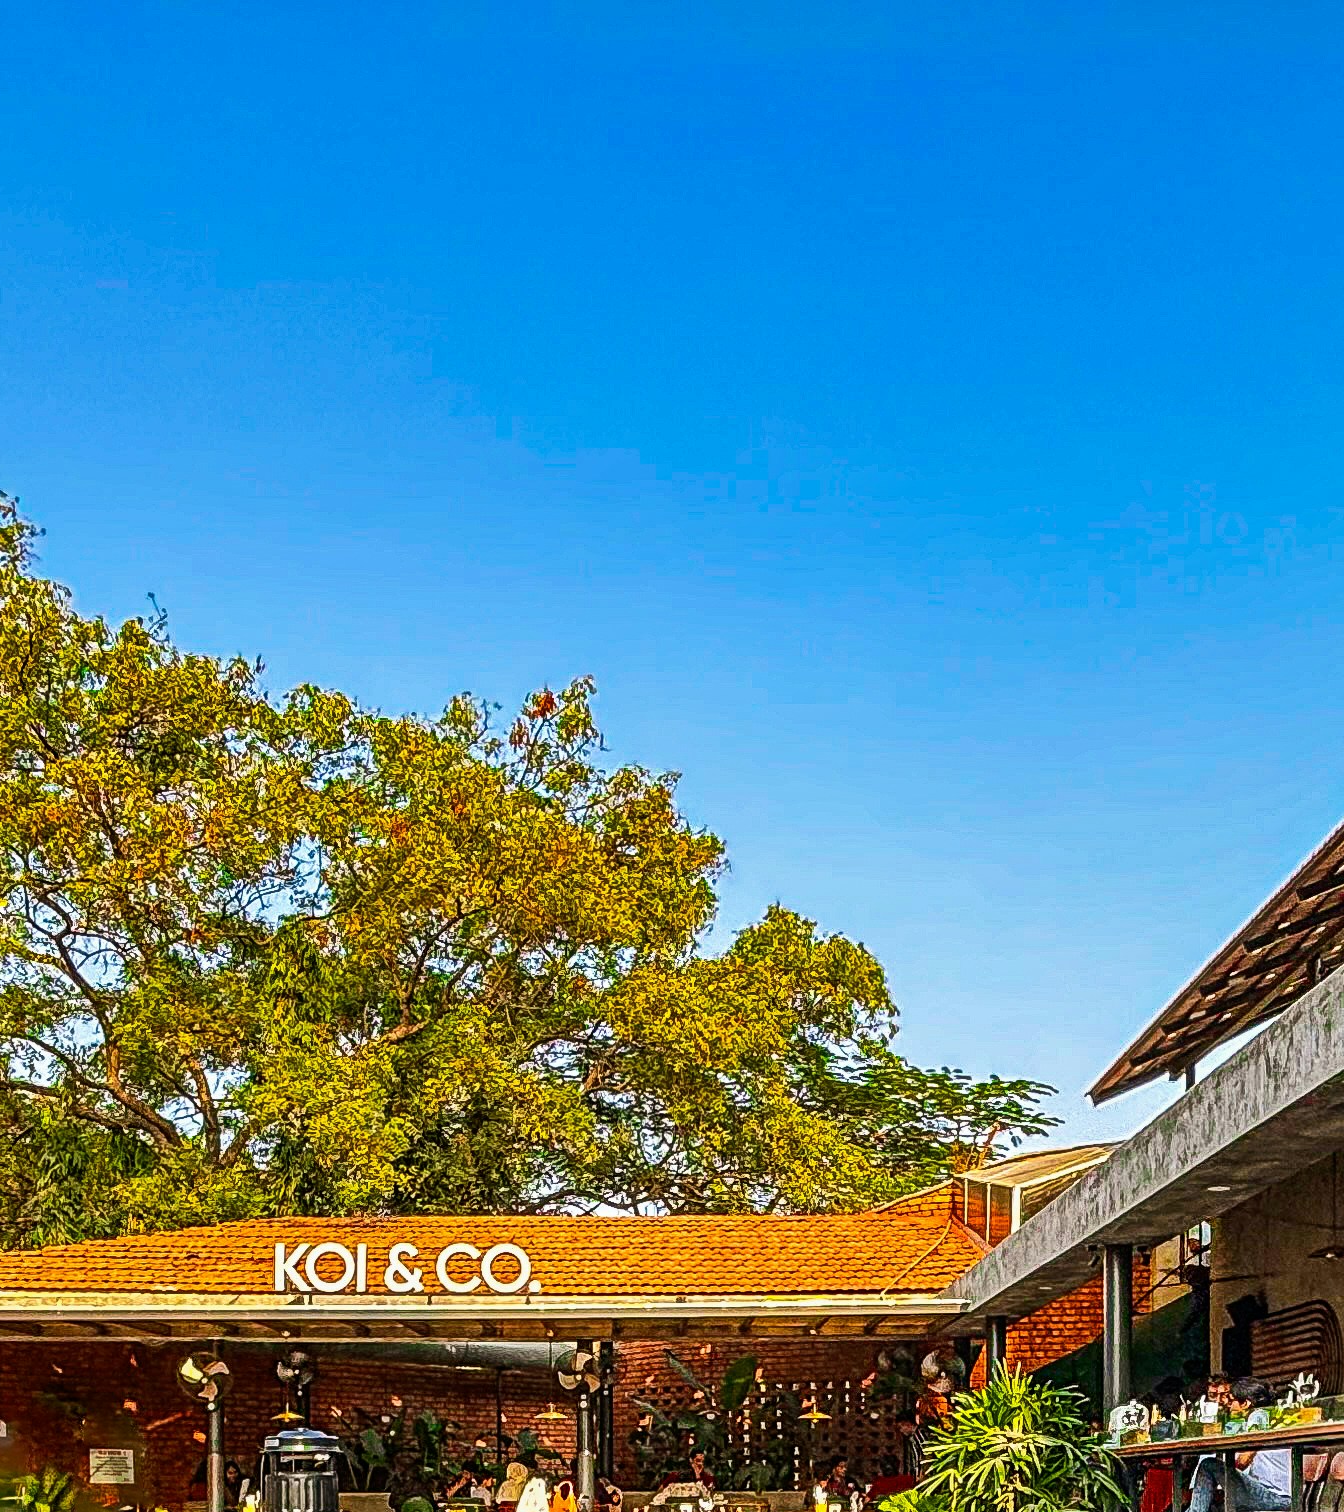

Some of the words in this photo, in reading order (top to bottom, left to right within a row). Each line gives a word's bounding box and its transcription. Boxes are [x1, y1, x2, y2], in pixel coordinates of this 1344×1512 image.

[274, 1243, 368, 1293] KOI
[383, 1243, 425, 1293] &
[435, 1243, 542, 1293] CO.
